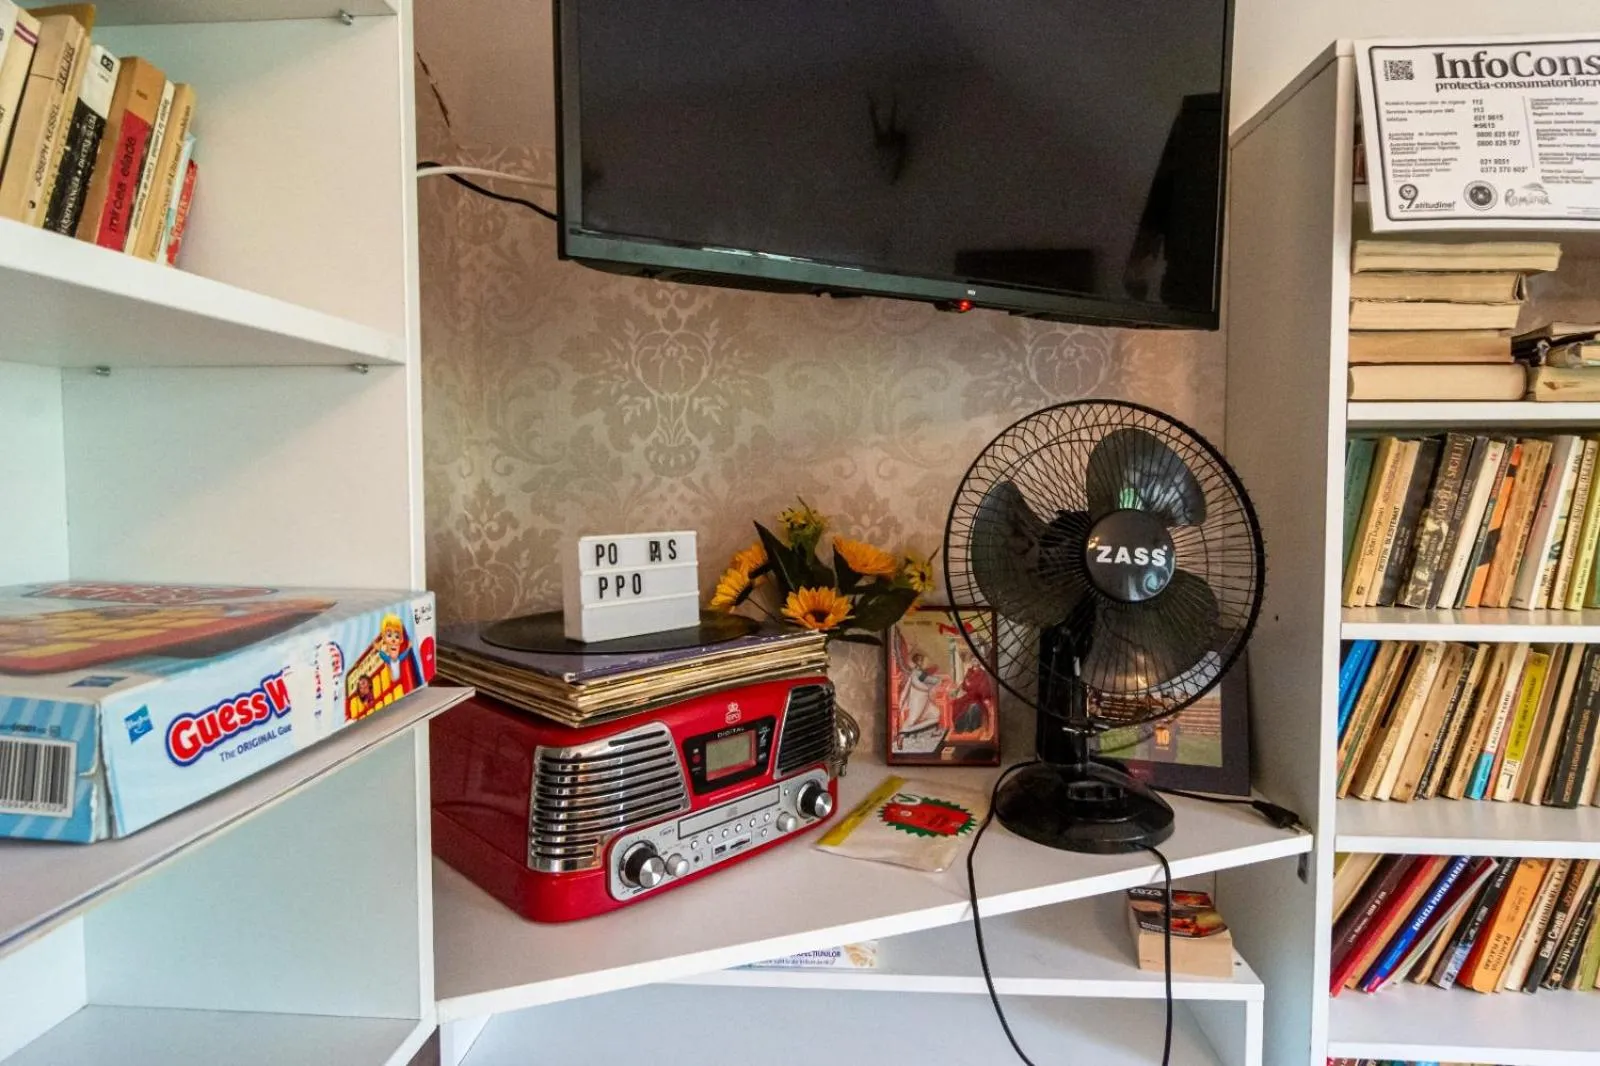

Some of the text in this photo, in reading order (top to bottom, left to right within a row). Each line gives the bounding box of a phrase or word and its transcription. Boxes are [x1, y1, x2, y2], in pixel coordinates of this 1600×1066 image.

[1432, 50, 1600, 79] InfoCons
[595, 542, 618, 567] PO
[1096, 545, 1167, 567] ZASS
[598, 573, 642, 599] PPO
[168, 690, 271, 763] Guess
[219, 748, 237, 762] The
[236, 730, 278, 755] ORIGINAL
